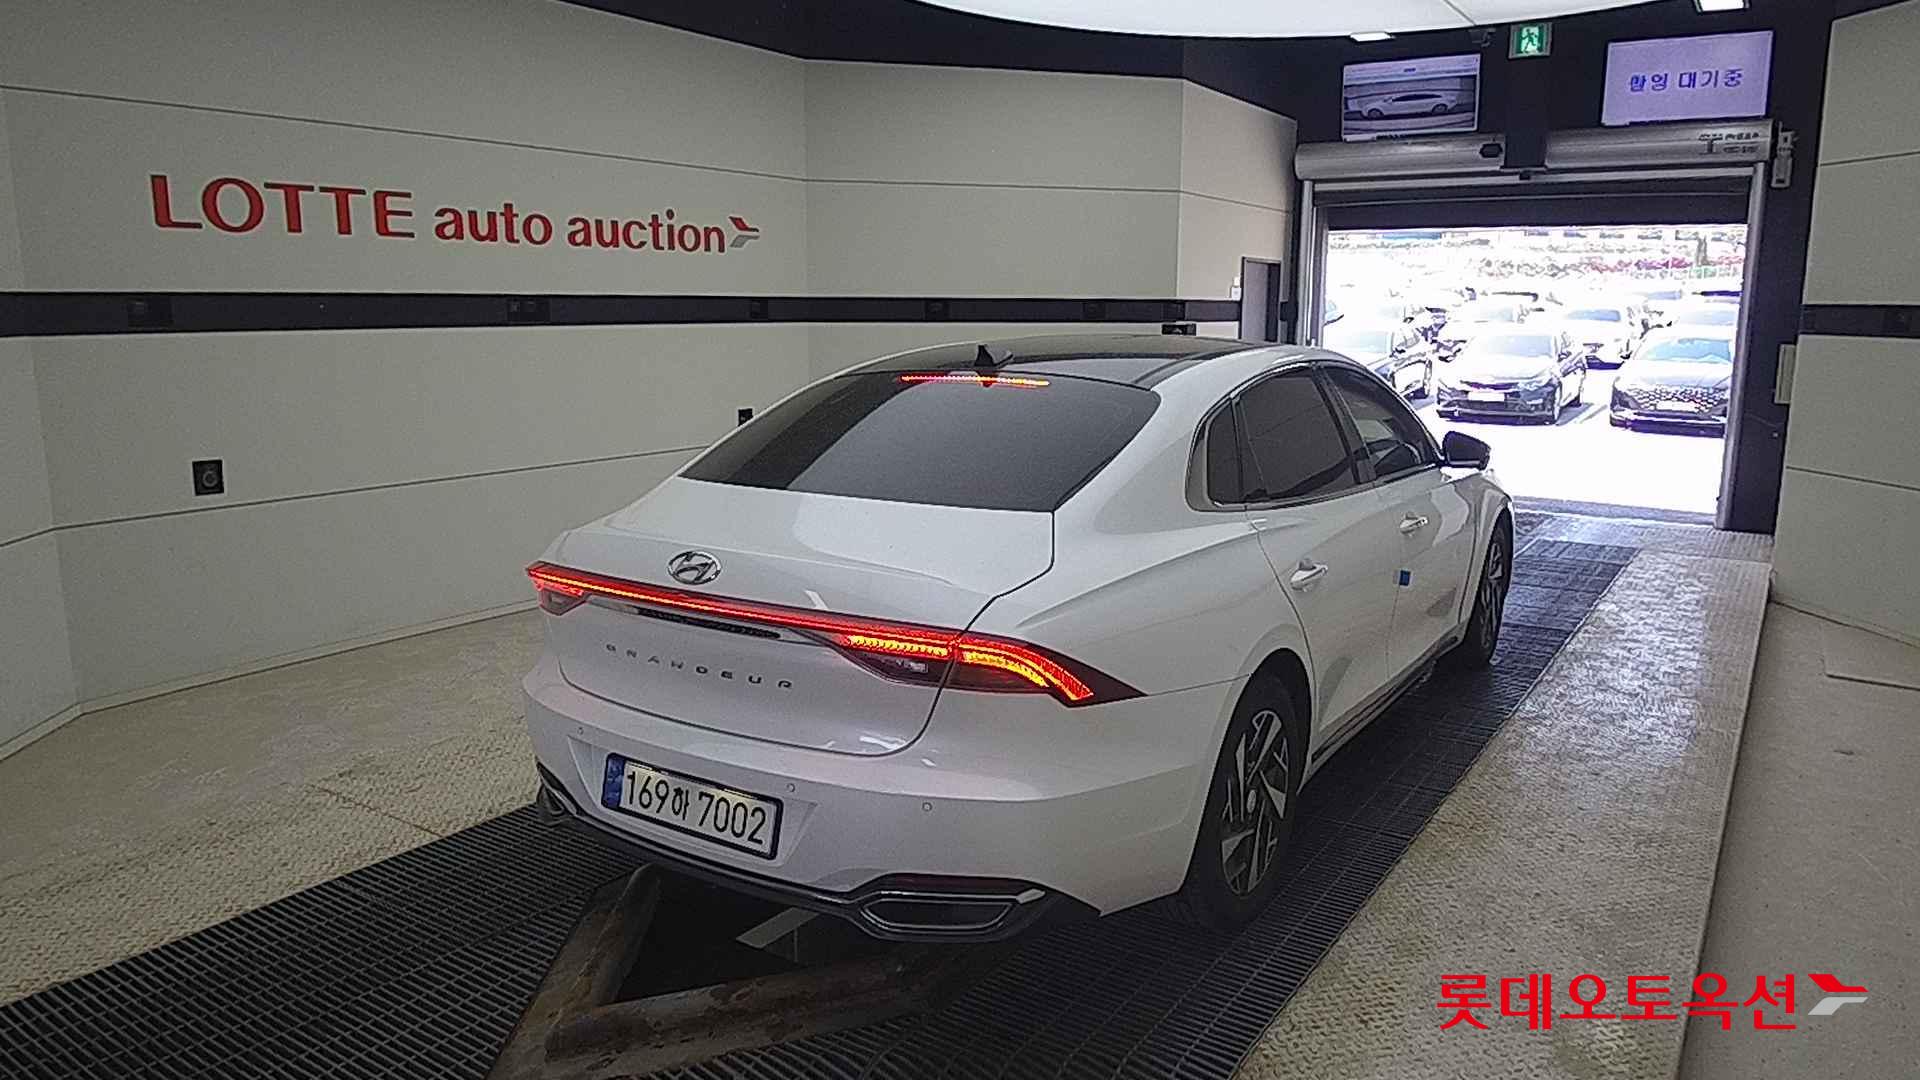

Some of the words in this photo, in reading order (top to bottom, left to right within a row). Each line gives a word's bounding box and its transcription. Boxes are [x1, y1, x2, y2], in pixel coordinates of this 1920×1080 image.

[149, 174, 416, 239] LOTTE
[433, 202, 553, 246] auto
[566, 209, 726, 254] auction
[627, 770, 691, 821] 169하
[698, 790, 767, 846] 7002
